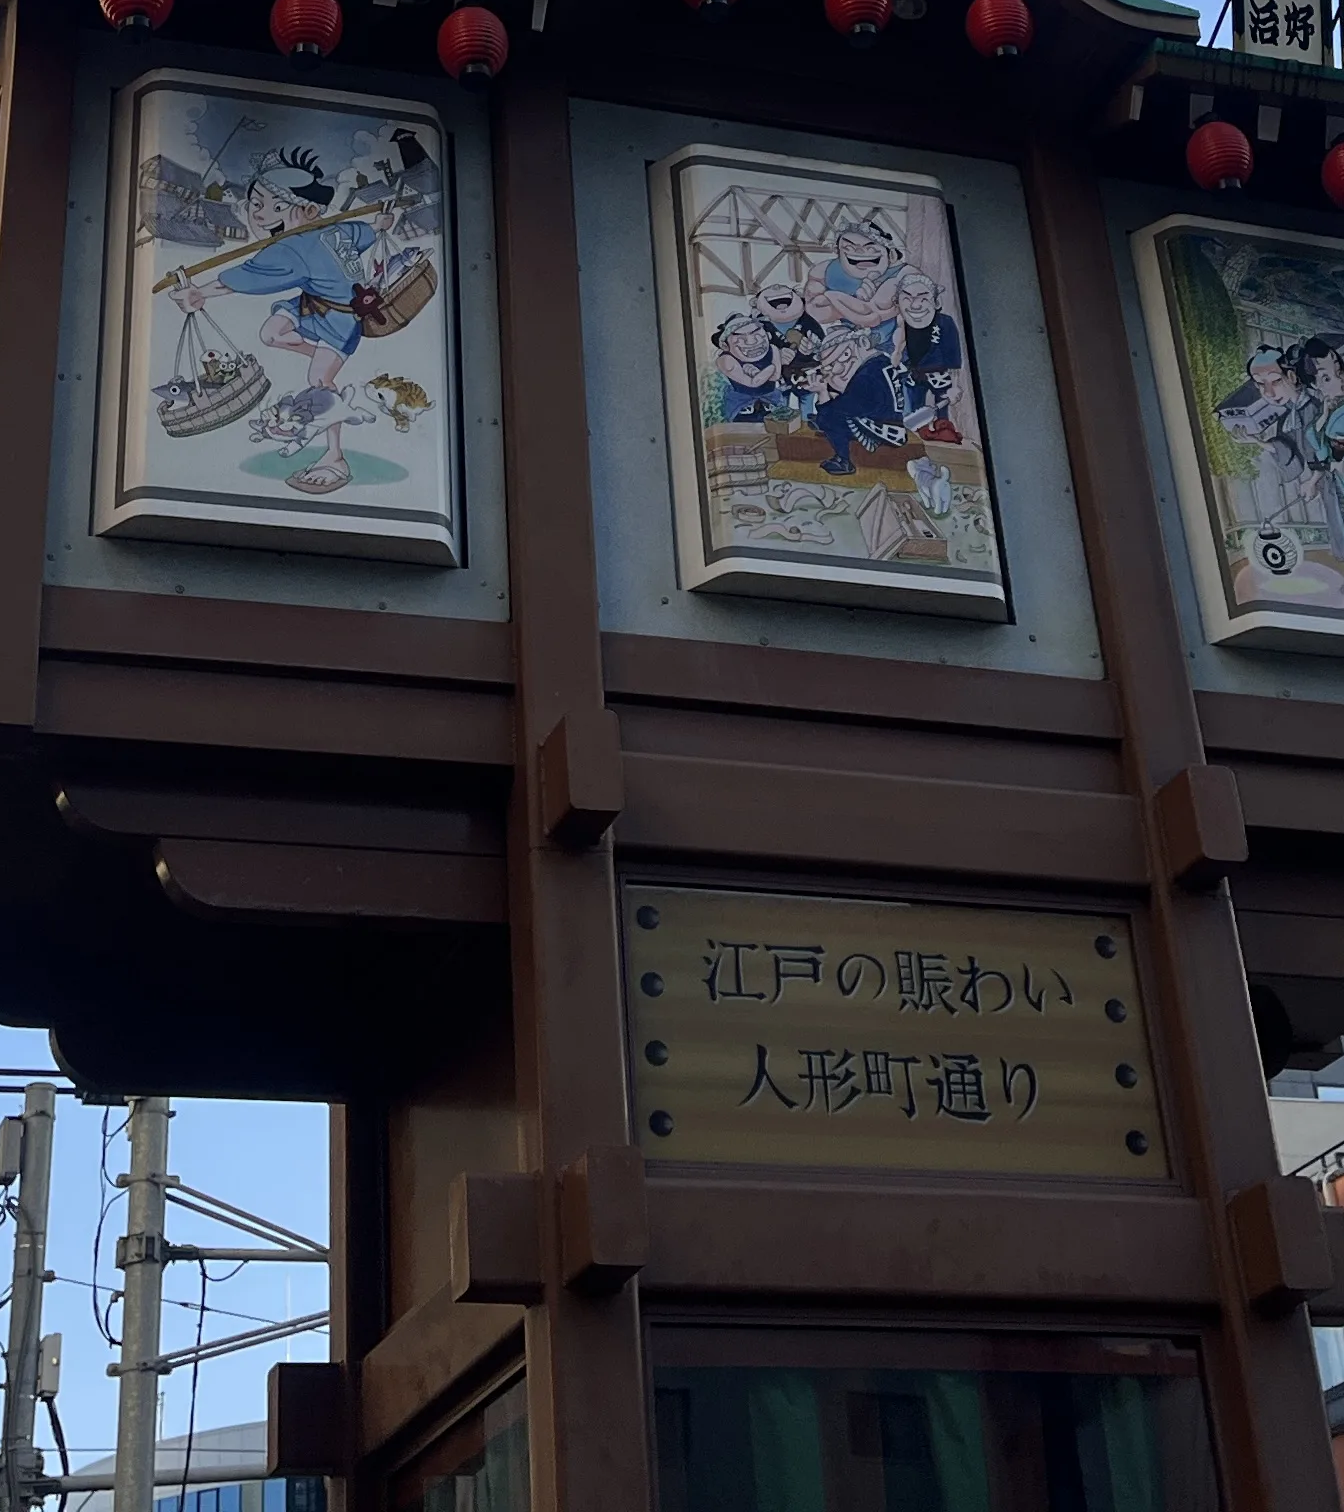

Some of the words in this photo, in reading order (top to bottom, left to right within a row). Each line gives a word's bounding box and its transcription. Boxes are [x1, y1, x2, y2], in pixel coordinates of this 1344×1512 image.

[702, 938, 1074, 1016] 江戸の賑わい
[737, 1044, 1038, 1123] 人形町通り
